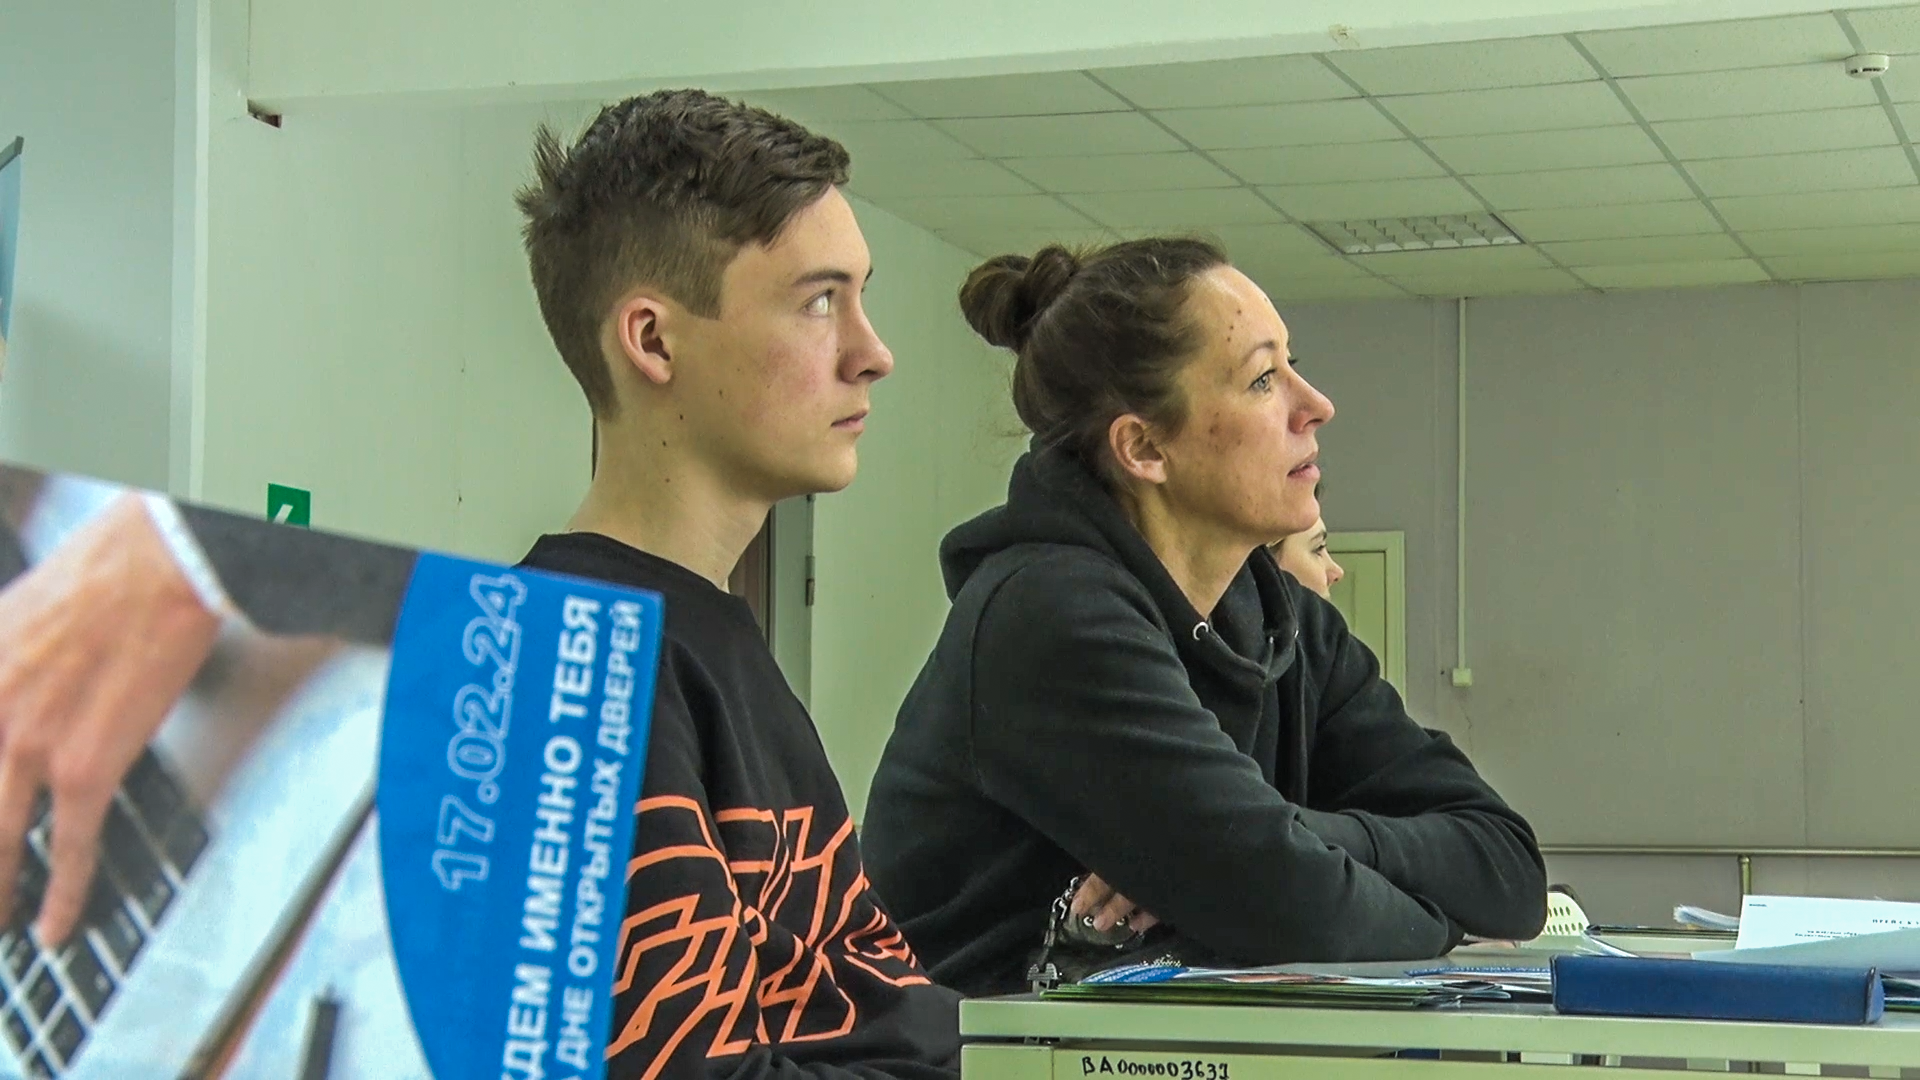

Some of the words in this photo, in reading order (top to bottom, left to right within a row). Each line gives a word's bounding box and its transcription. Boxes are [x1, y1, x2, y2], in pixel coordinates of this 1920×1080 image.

[431, 573, 527, 891] 17.02.24
[549, 594, 601, 723] ТЕБЯ
[598, 600, 643, 755] ДВЕРЕЙ
[519, 735, 583, 951] ИМЕННО
[567, 759, 622, 978] ОТКРЫТЫХ
[555, 985, 594, 1071] ДНЕ
